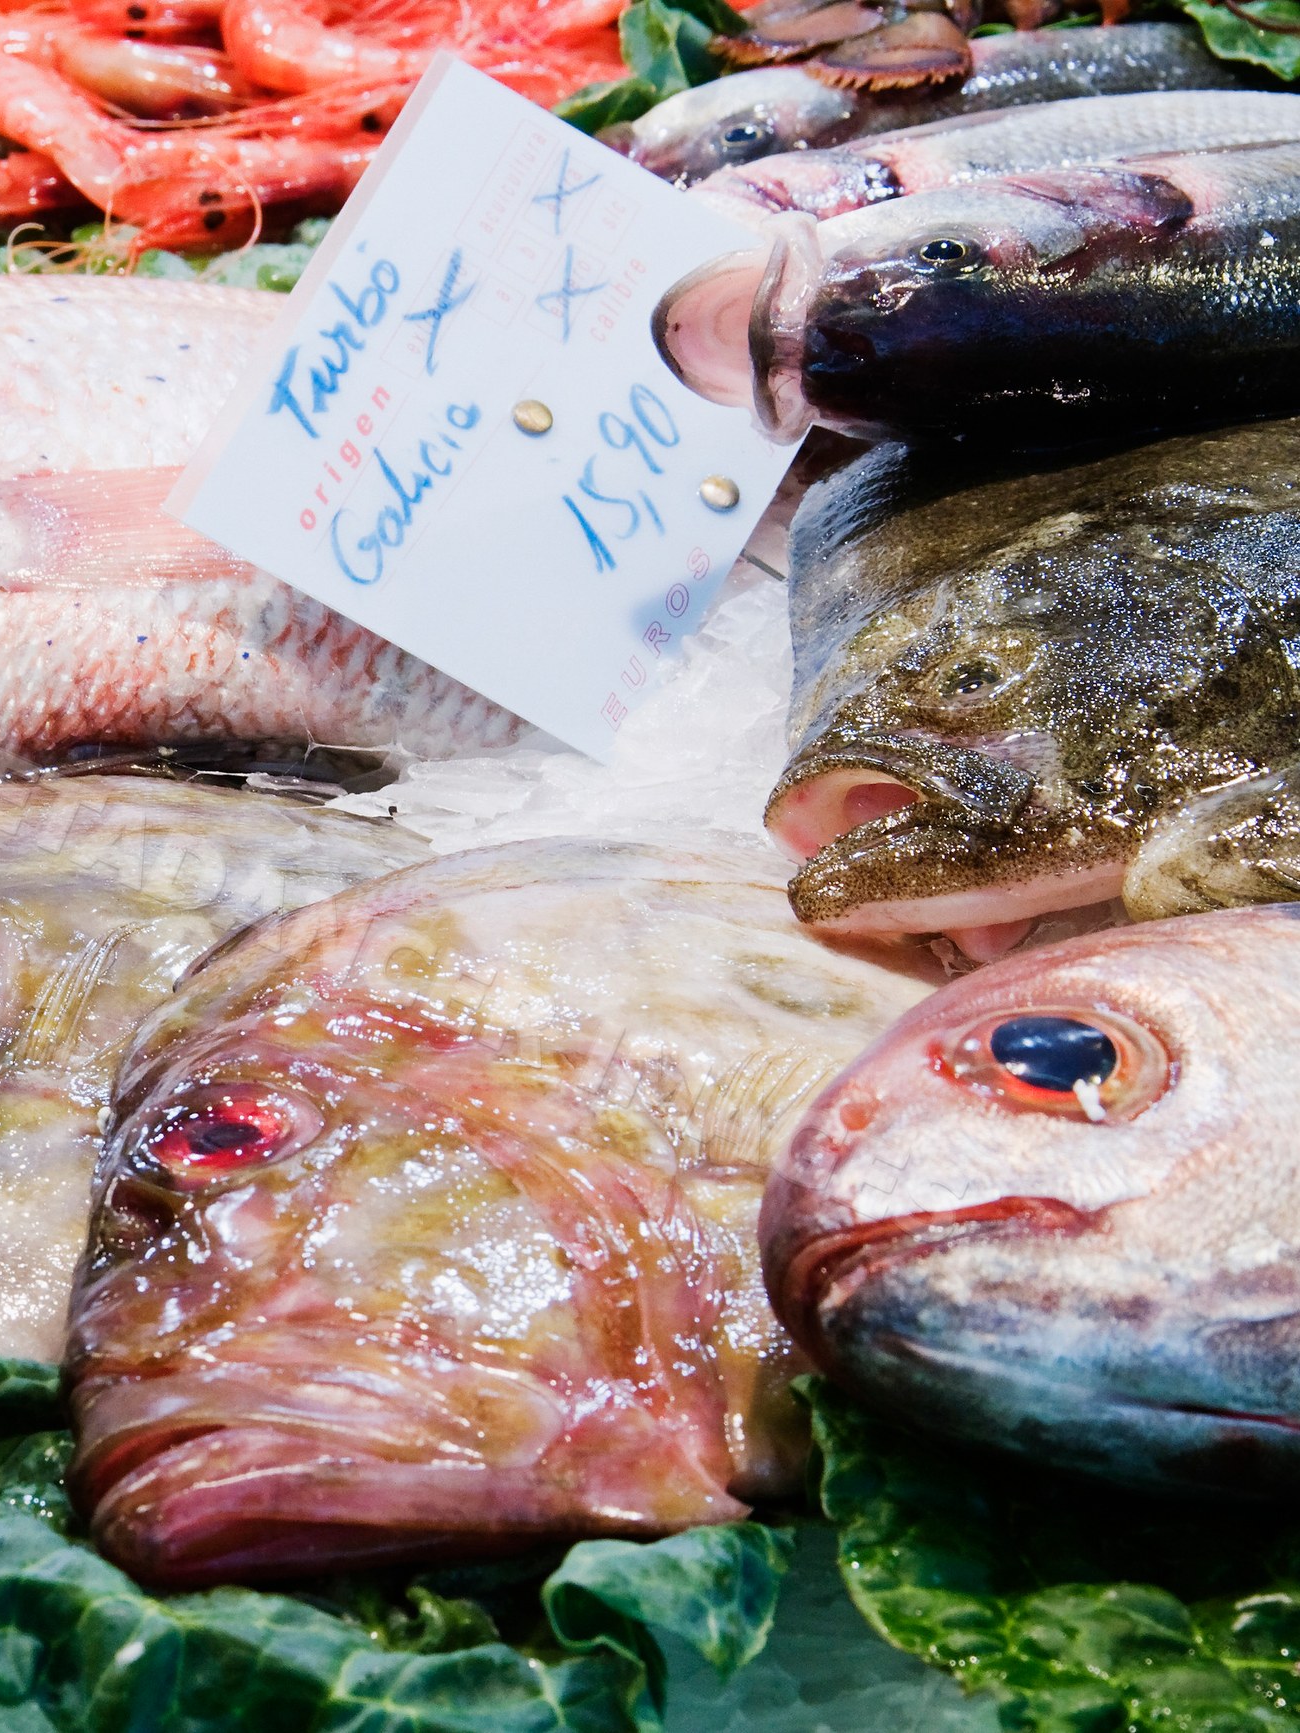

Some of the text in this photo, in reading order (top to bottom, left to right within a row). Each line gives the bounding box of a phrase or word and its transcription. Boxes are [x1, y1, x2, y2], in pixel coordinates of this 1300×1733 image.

[589, 257, 647, 343] calibre
[299, 385, 391, 531] origen
[562, 382, 680, 575] 15,90
[600, 547, 710, 732] EUROS
